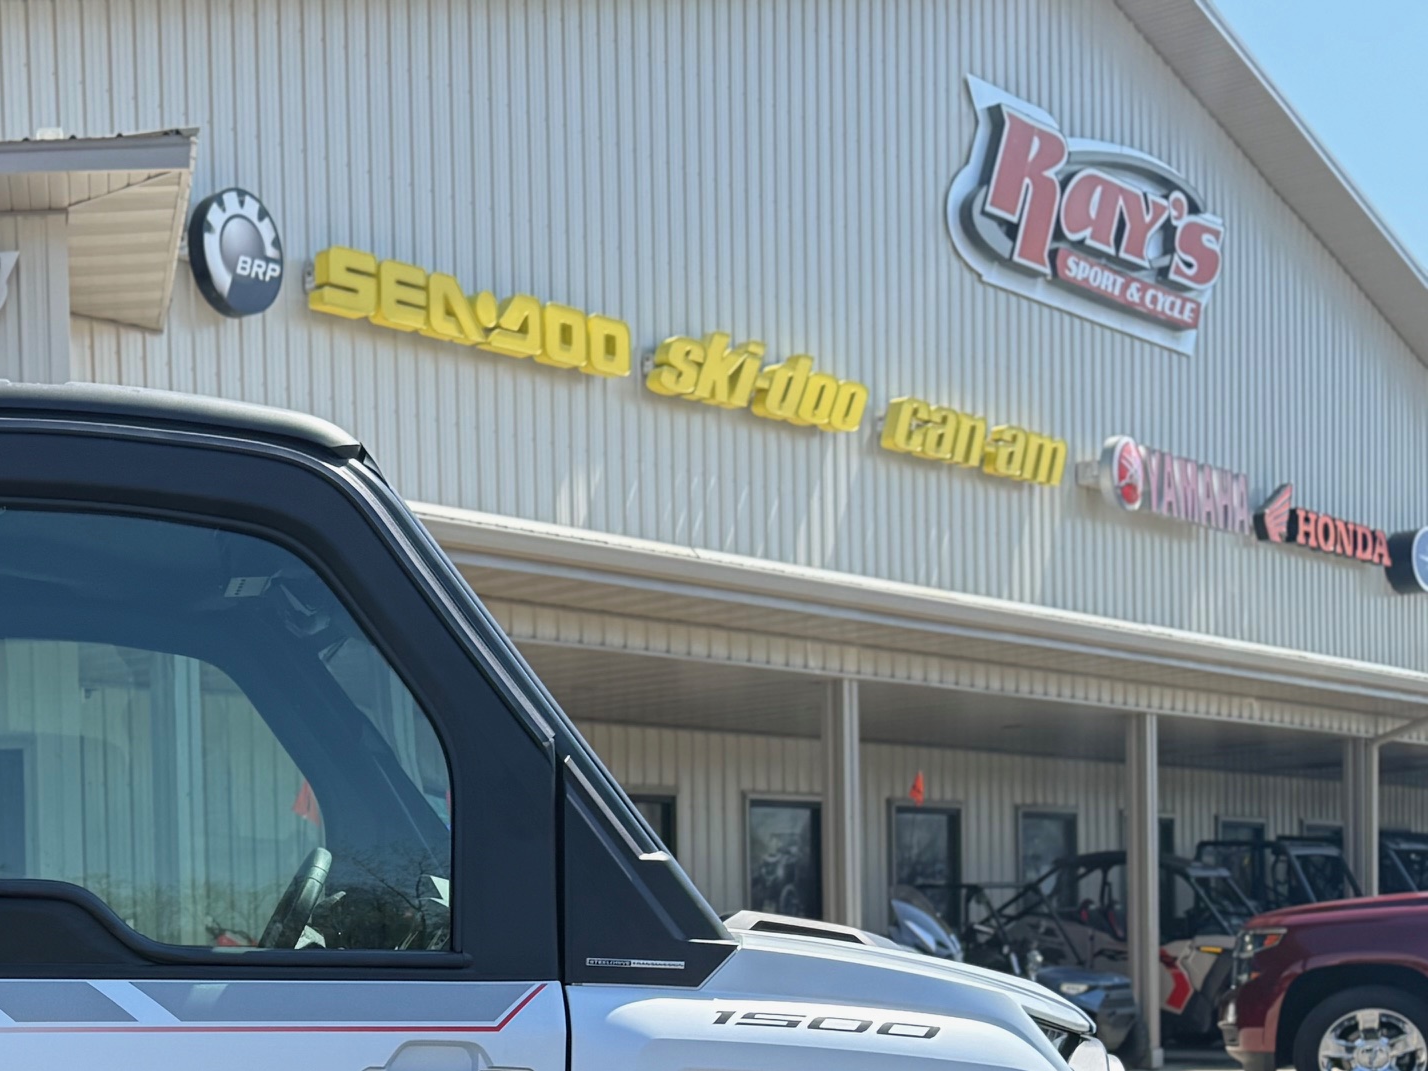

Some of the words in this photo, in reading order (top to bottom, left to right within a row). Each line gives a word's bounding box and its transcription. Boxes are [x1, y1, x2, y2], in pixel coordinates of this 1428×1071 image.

[235, 254, 281, 283] BRP
[1064, 255, 1125, 298] SPORT
[1125, 280, 1142, 304] &
[1144, 287, 1197, 324] CYCLE
[1147, 448, 1250, 536] YAMAHA
[1295, 507, 1393, 567] HONDA
[712, 1010, 941, 1040] 1500
